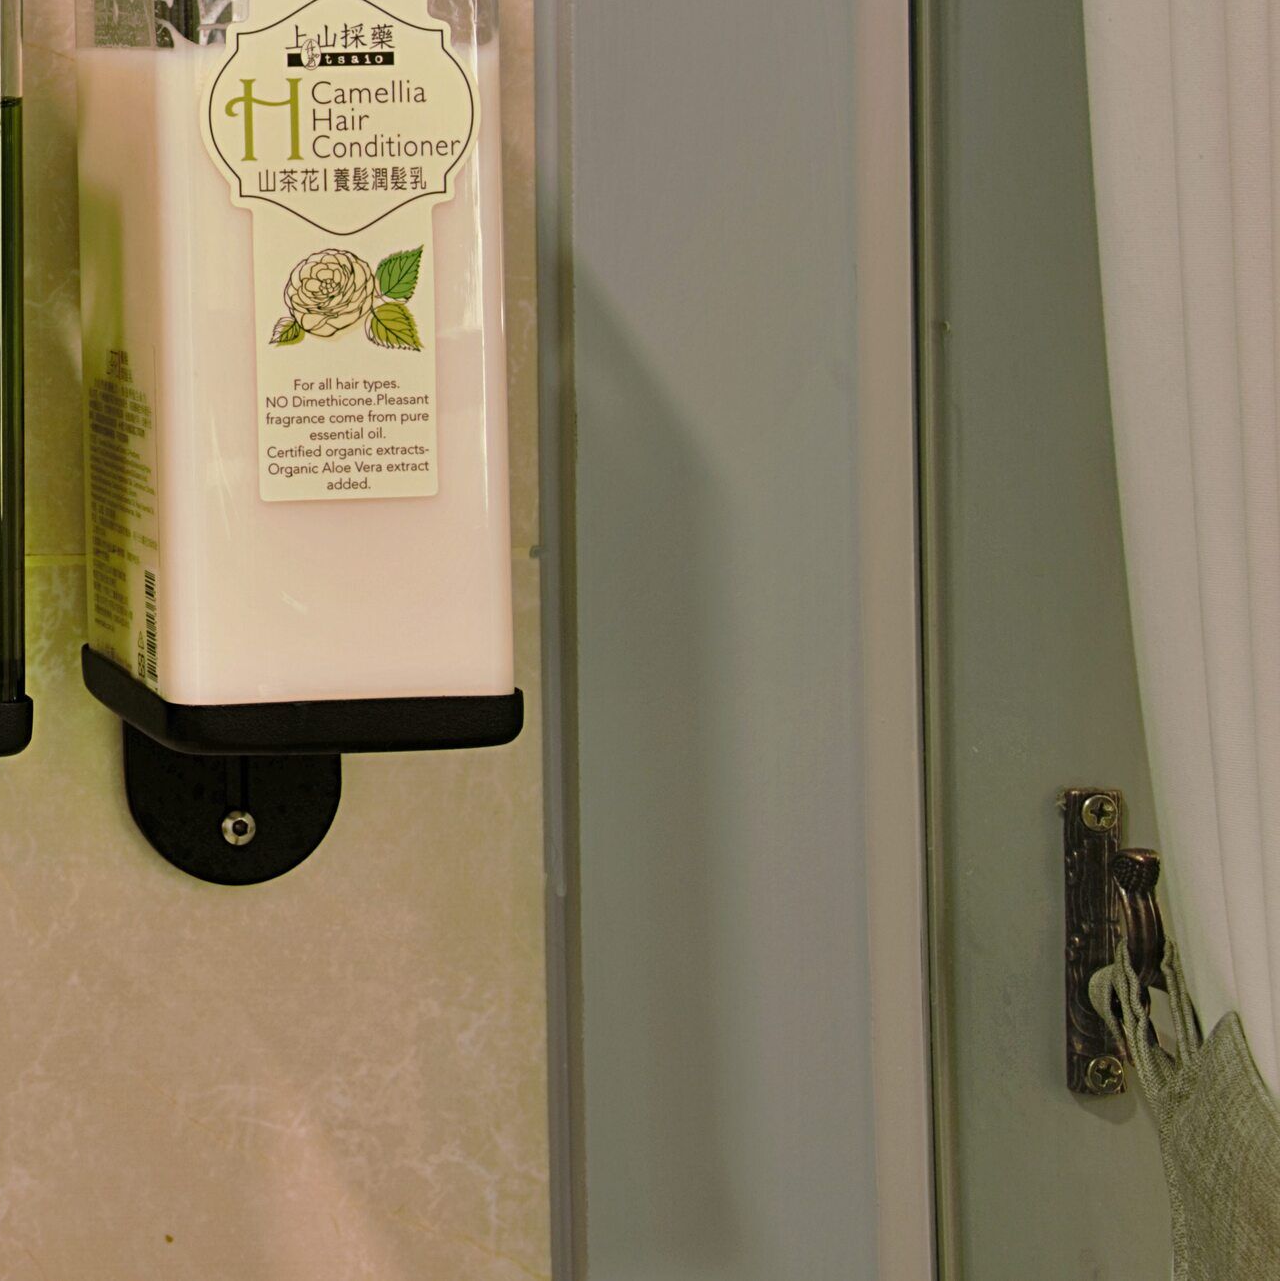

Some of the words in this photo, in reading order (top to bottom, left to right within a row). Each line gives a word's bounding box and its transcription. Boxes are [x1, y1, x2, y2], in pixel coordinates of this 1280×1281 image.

[285, 23, 395, 51] 上山採藥
[311, 80, 426, 105] Camellia
[313, 107, 370, 132] Hair
[312, 134, 460, 159] Conditioner
[294, 379, 314, 391] For
[318, 378, 331, 390] all
[336, 378, 359, 389] hair
[363, 379, 400, 392] types.
[266, 396, 288, 408] NO
[266, 413, 325, 427] fragrance
[329, 413, 364, 424] come
[368, 411, 396, 422] from
[401, 411, 429, 425] pure
[309, 428, 363, 440] essential
[368, 427, 386, 439] oil.
[267, 446, 321, 458] Certified
[326, 446, 372, 459] organic
[268, 463, 319, 478] Organic
[322, 462, 351, 473] Aloe
[355, 462, 382, 472] Vera
[386, 461, 429, 472] extract
[327, 478, 371, 490] added.
